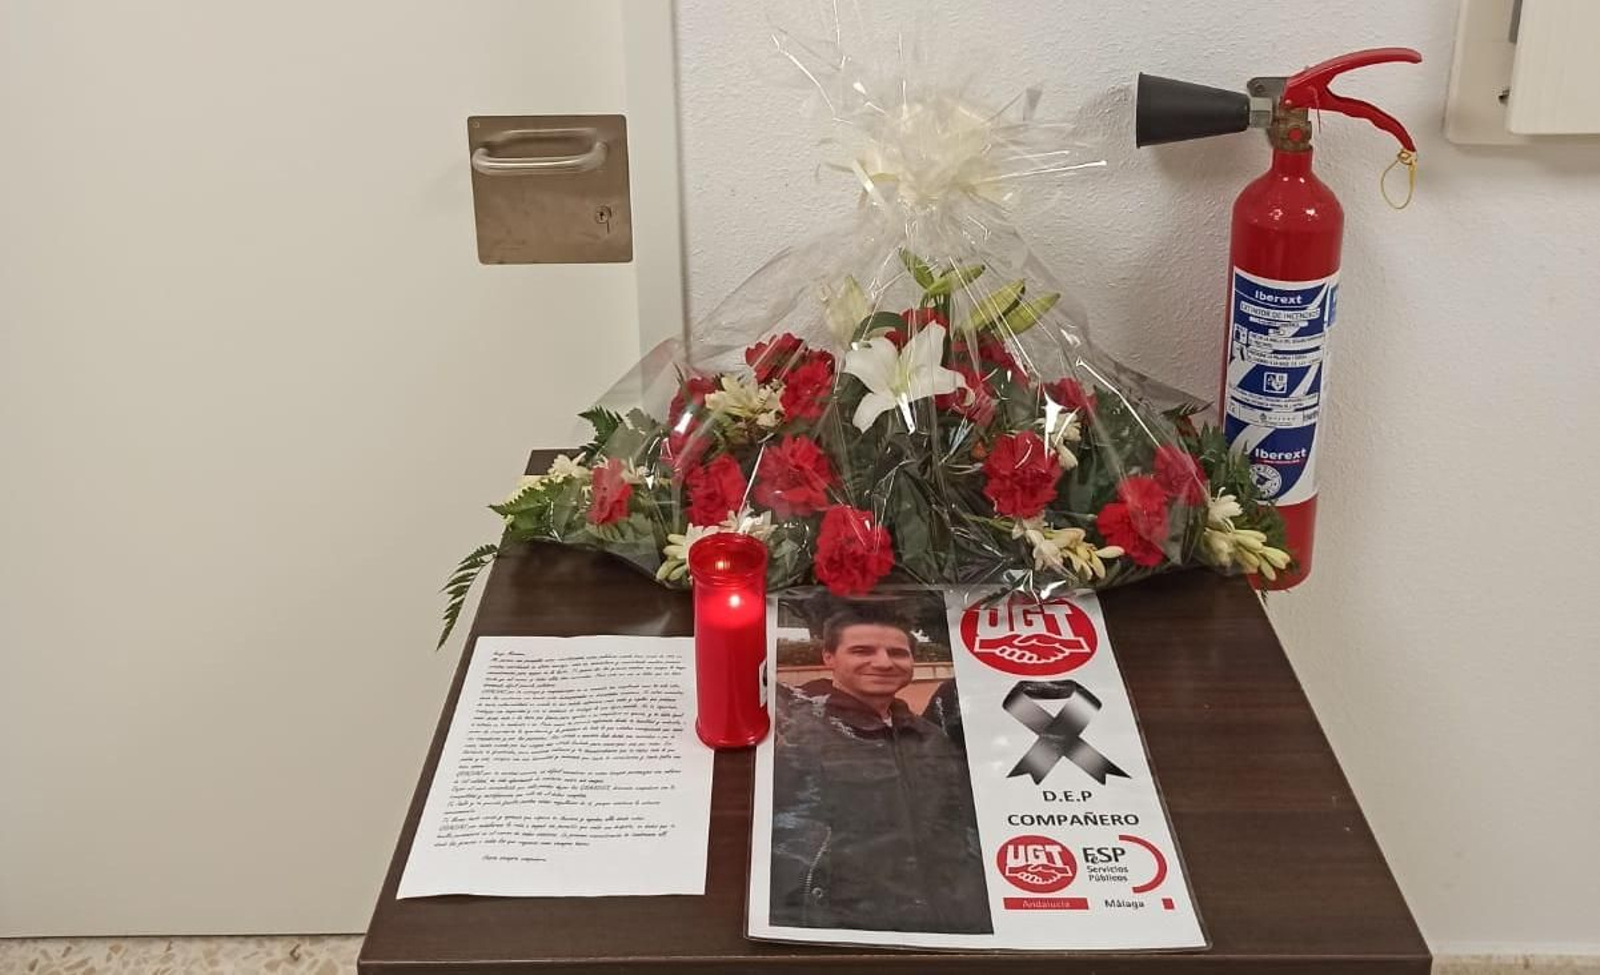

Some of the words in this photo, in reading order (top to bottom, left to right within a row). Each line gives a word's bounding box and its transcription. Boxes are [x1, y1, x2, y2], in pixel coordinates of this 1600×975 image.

[1255, 290, 1302, 304] Iberext
[1255, 448, 1307, 460] Iberext
[977, 602, 1076, 640] UGT
[1042, 790, 1093, 802] D.E.P
[1007, 812, 1140, 826] COMPAÑERO
[1006, 844, 1064, 867] UGT
[1087, 866, 1129, 874] Servicios
[1088, 874, 1129, 882] Públicos
[1105, 899, 1145, 910] Málaga
